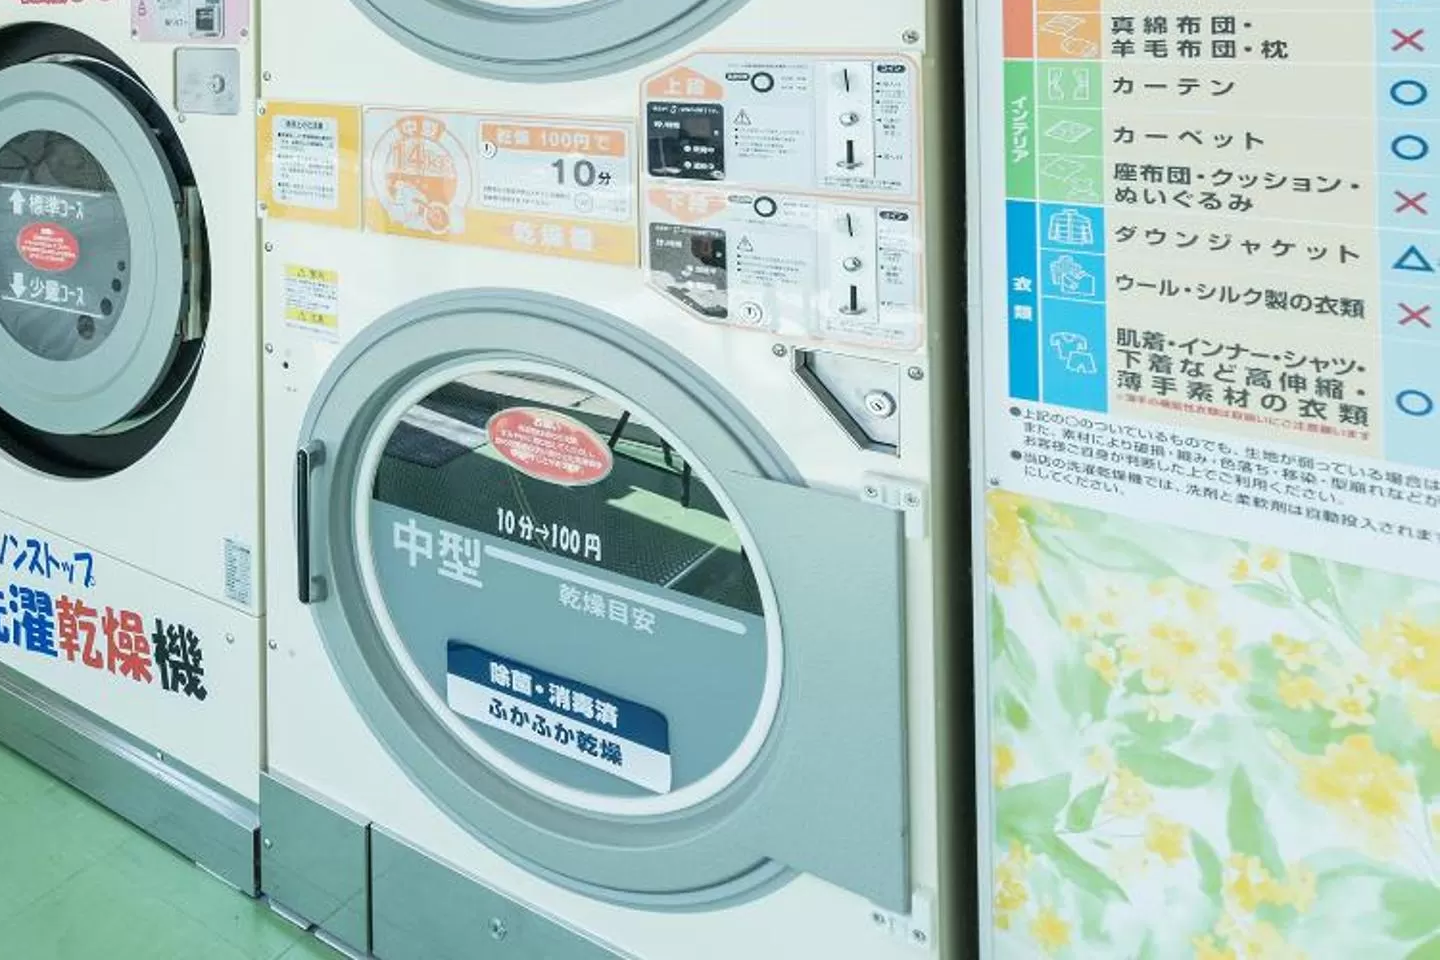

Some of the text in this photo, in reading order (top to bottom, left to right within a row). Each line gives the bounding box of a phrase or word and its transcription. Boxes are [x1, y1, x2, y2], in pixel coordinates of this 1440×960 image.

[1111, 39, 1289, 60] 羊毛布団・枕
[1112, 76, 1235, 97] カーテン
[1113, 126, 1265, 151] カーペット
[550, 157, 612, 188] 10分
[29, 192, 84, 220] 標準コース
[1114, 186, 1254, 213] ぬいぐるみ
[1115, 224, 1361, 265] ダウンジャケット
[29, 276, 86, 307] 少量コース
[1115, 274, 1366, 320] ウール・シルク製の衣類
[1117, 368, 1370, 428] 薄手素材の衣類
[1023, 450, 1440, 542] 当店の洗濯乾燥機では、洗剤と柔軟剤は自動投入されま
[392, 518, 483, 589] 中型
[559, 583, 657, 635] 乾燥目安
[488, 661, 619, 729] 除菌・消毒済
[488, 696, 623, 767] ふかふか乾燥
